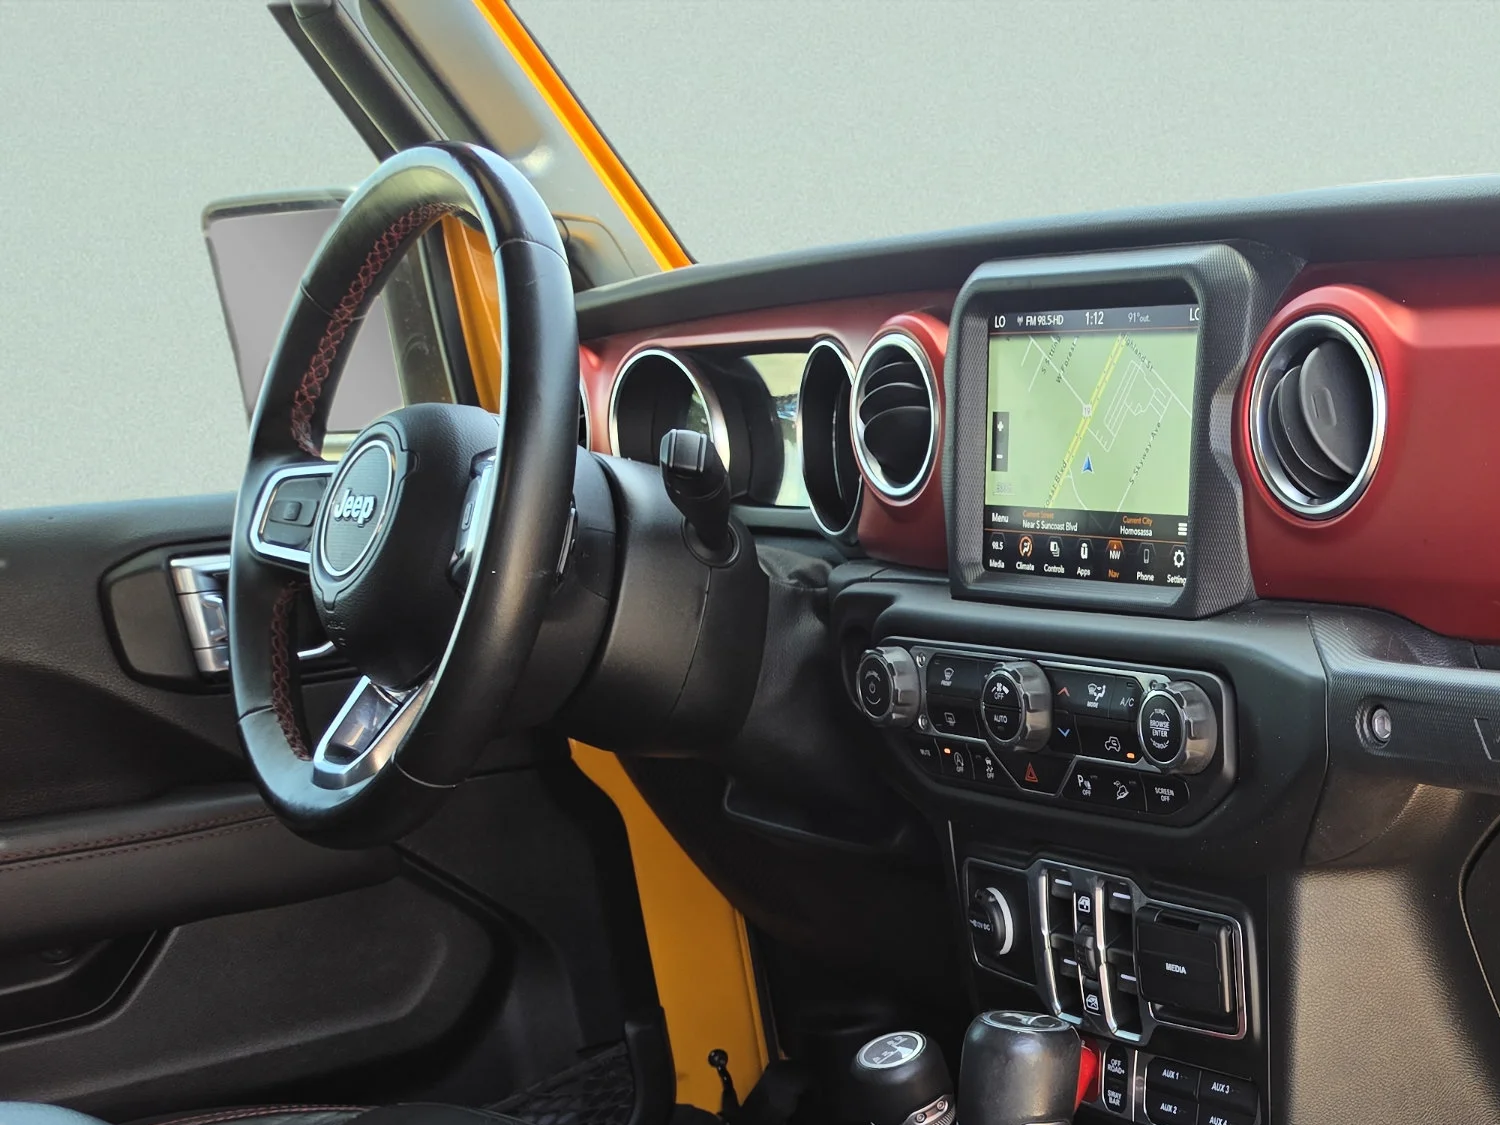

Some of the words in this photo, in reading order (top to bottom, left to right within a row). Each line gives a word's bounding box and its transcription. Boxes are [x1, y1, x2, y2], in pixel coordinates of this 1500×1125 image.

[994, 315, 1006, 329] LO
[1025, 316, 1037, 327] FM
[1037, 314, 1064, 327] 98.5-HD
[1085, 311, 1104, 326] 1:12
[333, 487, 376, 528] Jeep
[991, 513, 1009, 524] Menu
[1142, 516, 1153, 527] City
[1022, 519, 1035, 529] Near
[1041, 520, 1065, 531] Suncoast
[1065, 521, 1078, 532] Blvd
[1120, 525, 1153, 537] Homosassa
[992, 541, 1004, 551] 98.5
[1109, 549, 1121, 560] NW
[989, 559, 1005, 569] Media
[1016, 561, 1035, 571] Climate
[1043, 563, 1065, 574] Controls
[1076, 566, 1091, 577] Apps
[1108, 569, 1120, 578] Nav
[1136, 571, 1155, 582] Phone
[993, 692, 1004, 701] OFF
[1119, 697, 1135, 708] A/C
[993, 714, 1008, 724] AUTO
[1149, 719, 1170, 729] BROWSE
[1151, 729, 1168, 738] ENTER
[1154, 786, 1175, 797] SCREEN
[1160, 795, 1171, 803] OFF
[1165, 962, 1187, 975] MEDIA
[1161, 1068, 1174, 1079] AUX
[1211, 1081, 1224, 1093] AUX
[1160, 1102, 1173, 1113] AUX
